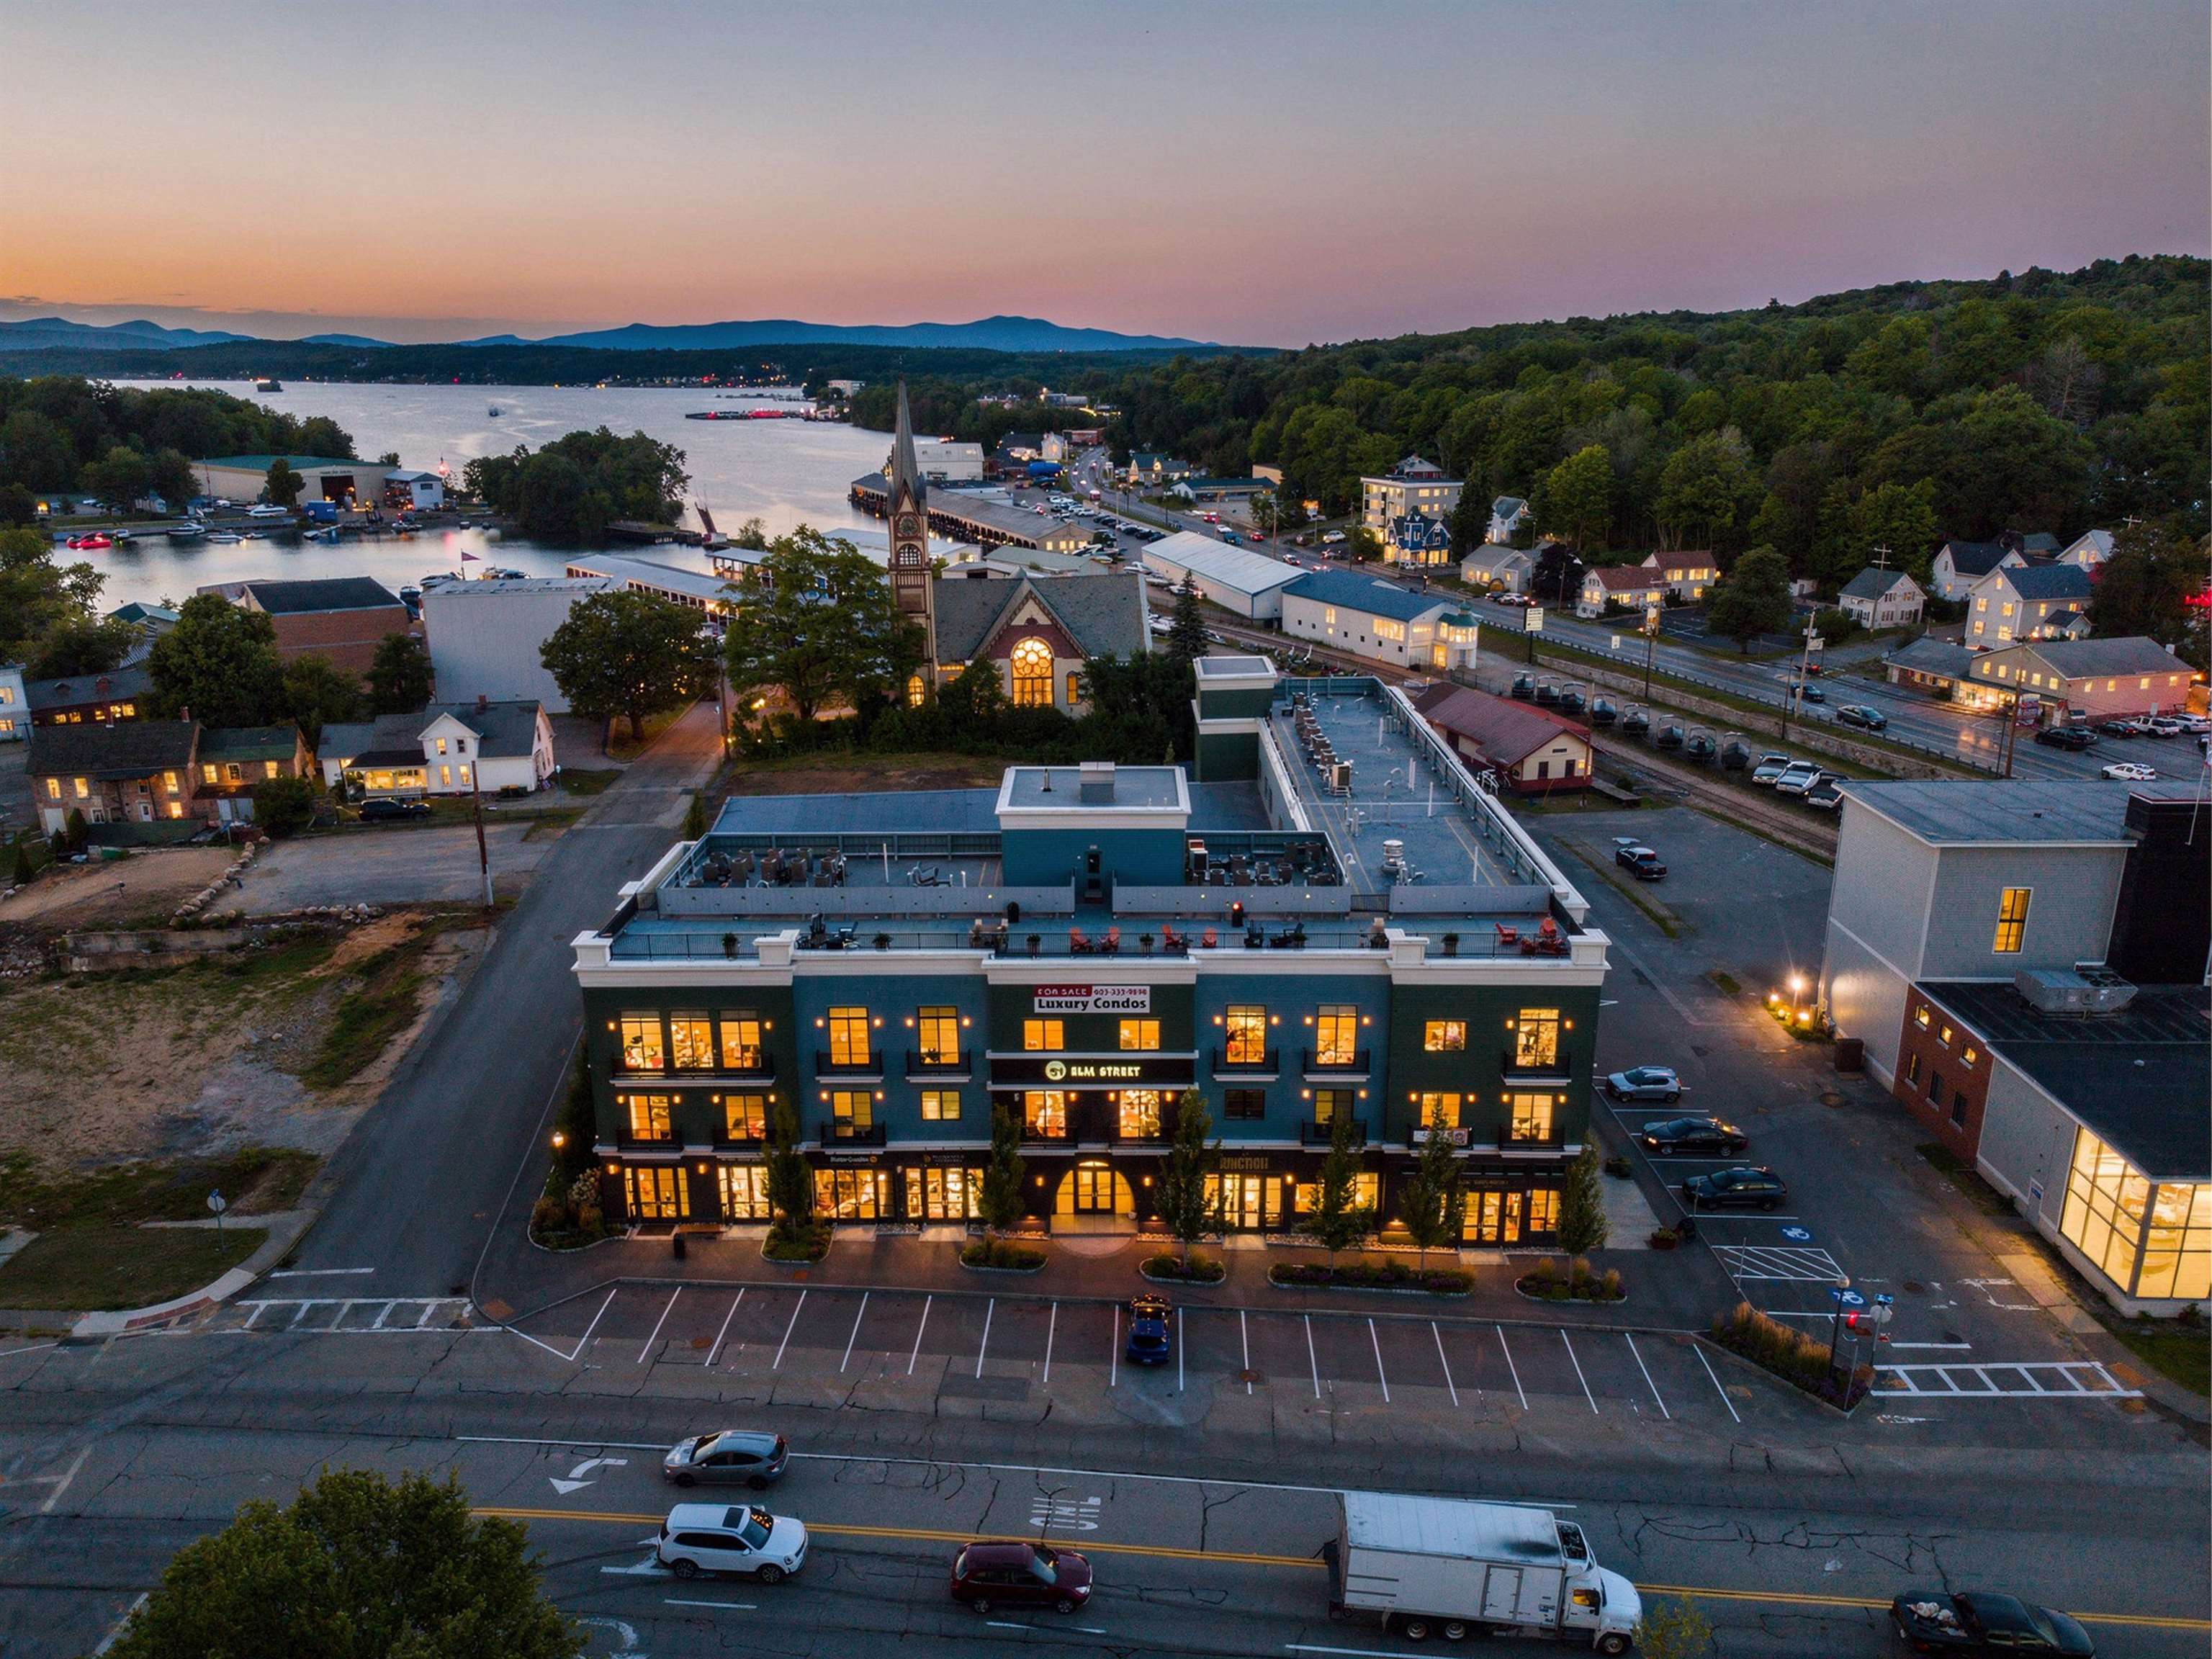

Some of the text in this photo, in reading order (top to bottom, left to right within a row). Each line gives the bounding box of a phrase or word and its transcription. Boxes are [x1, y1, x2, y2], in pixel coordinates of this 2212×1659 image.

[1038, 998, 1146, 1011] Luxury Condos
[1071, 1066, 1095, 1077] ELM
[1100, 1066, 1141, 1077] STREET
